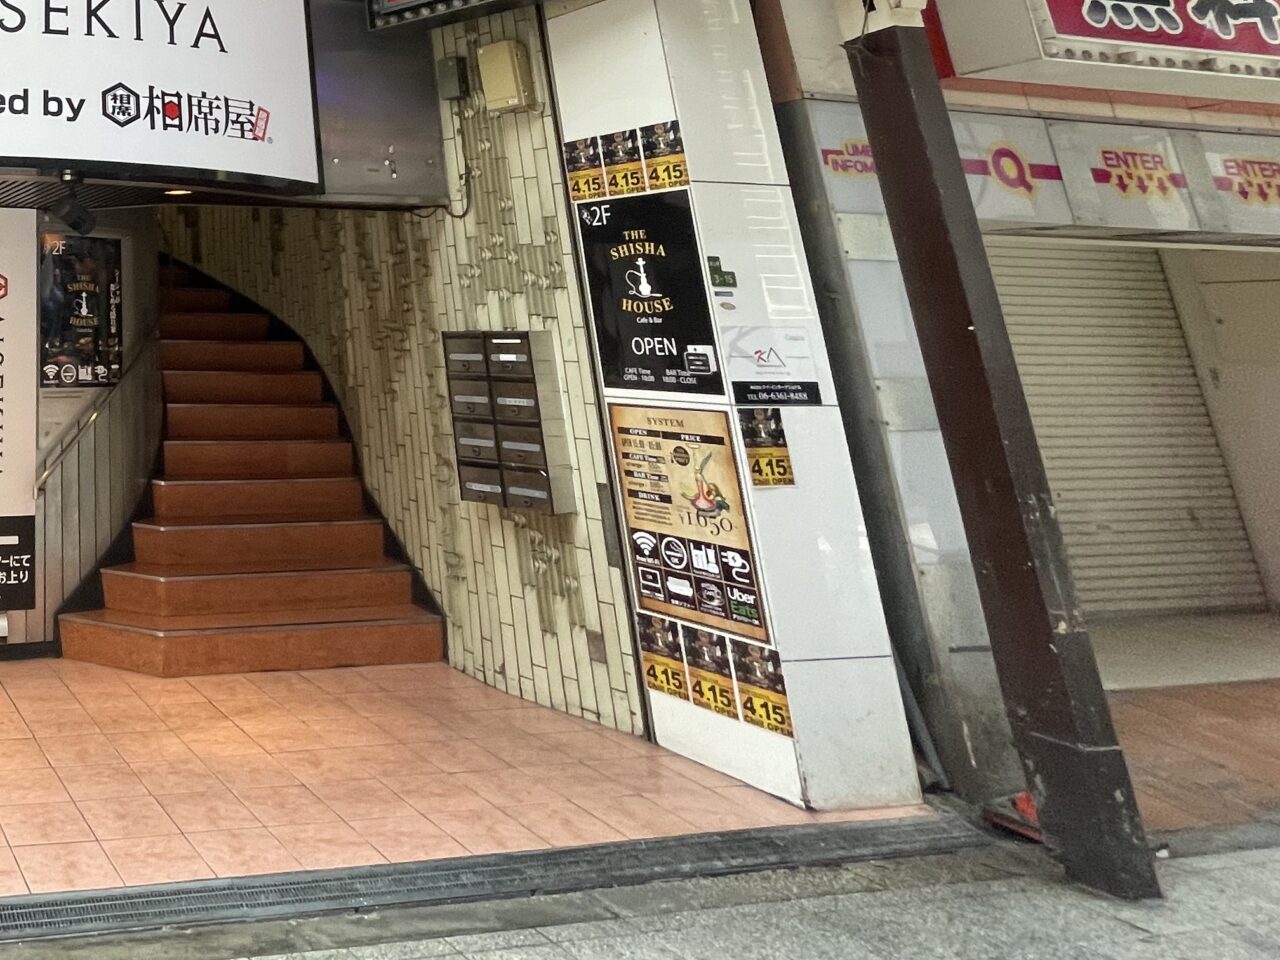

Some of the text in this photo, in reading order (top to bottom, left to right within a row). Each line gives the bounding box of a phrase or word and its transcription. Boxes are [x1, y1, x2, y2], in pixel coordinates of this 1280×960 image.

[41, 88, 87, 123] by
[141, 84, 262, 143] 相席屋
[1101, 149, 1166, 171] ENTER
[608, 171, 640, 189] 4.15
[649, 164, 684, 182] 4.15
[572, 177, 601, 194] 4.15
[590, 204, 612, 226] 2F
[623, 229, 647, 241] THE
[52, 240, 67, 256] 2F
[609, 241, 666, 261] SHISHA
[621, 297, 674, 314] HOUSE
[69, 316, 100, 327] HOUSE
[631, 336, 678, 356] OPEN
[646, 417, 684, 428] SYSTEM
[751, 458, 788, 477] 4.15
[726, 586, 756, 605] Uber
[730, 600, 758, 619] Eats
[646, 663, 683, 691] 4.15
[692, 679, 732, 708] 4.15
[743, 696, 786, 726] 4.15
